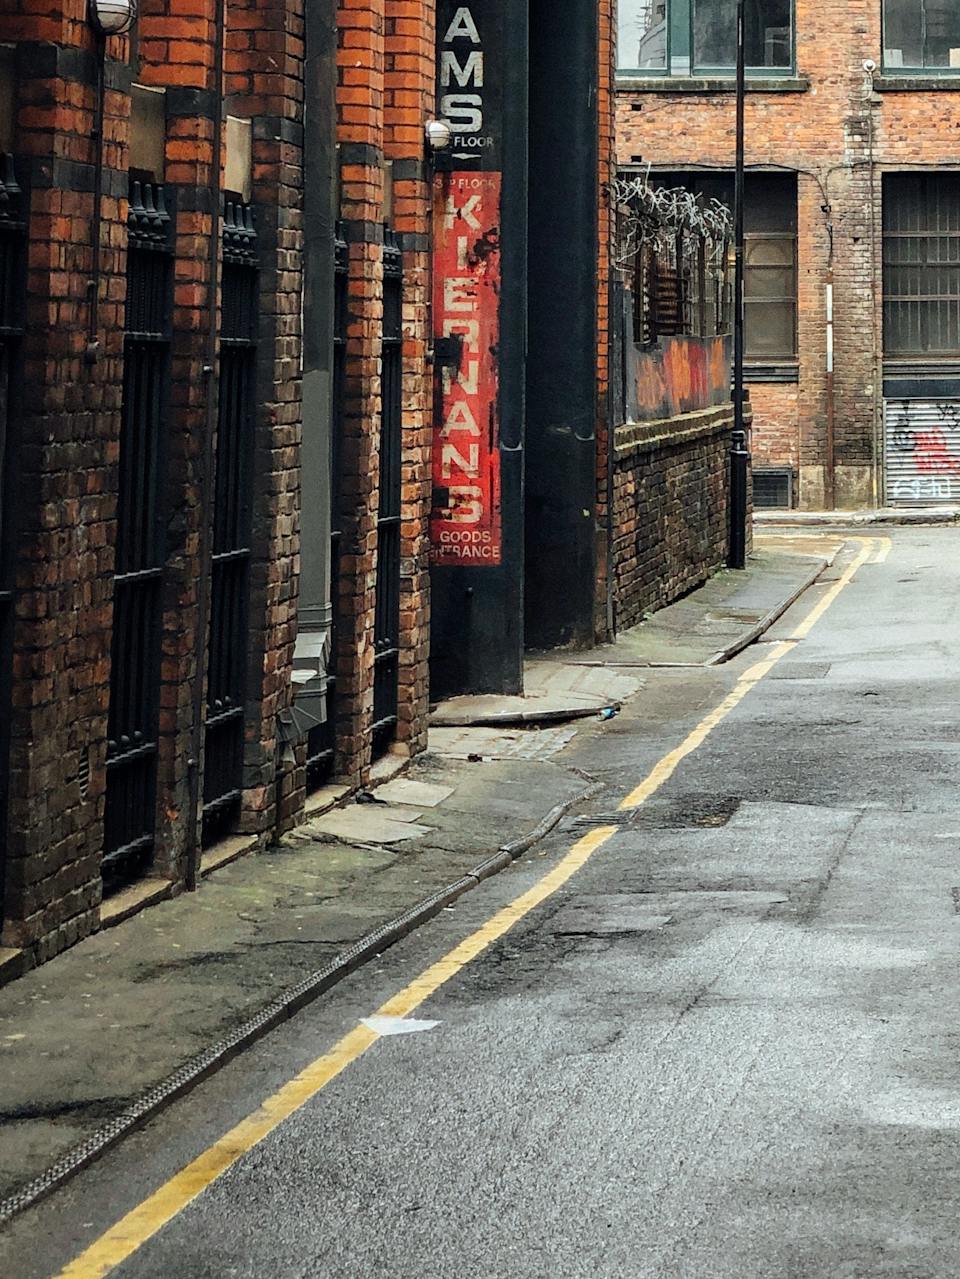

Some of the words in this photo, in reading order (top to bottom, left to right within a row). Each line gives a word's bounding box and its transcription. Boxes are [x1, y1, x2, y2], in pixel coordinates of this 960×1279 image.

[454, 136, 494, 147] FLOOR
[458, 178, 496, 189] FLOOR
[439, 195, 484, 524] KIERNANS
[440, 530, 491, 543] GOODS
